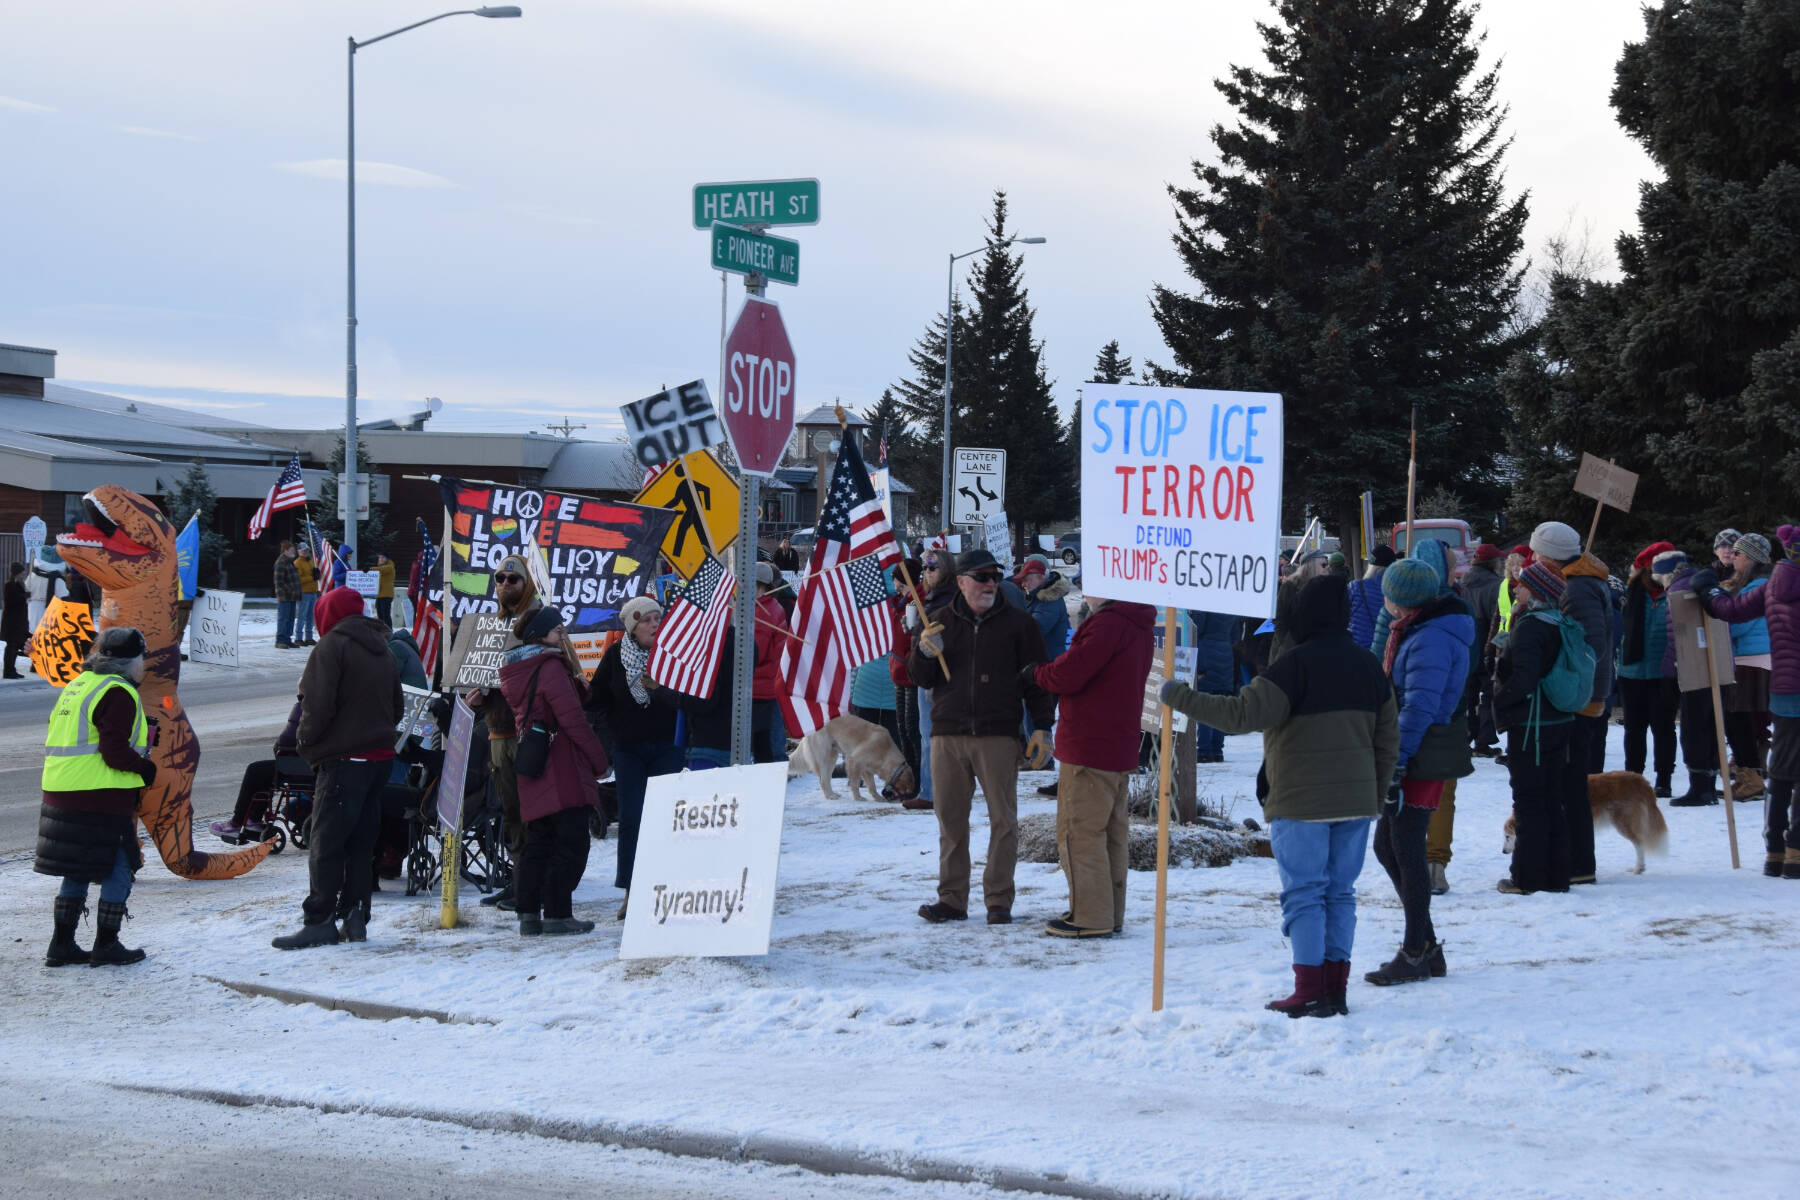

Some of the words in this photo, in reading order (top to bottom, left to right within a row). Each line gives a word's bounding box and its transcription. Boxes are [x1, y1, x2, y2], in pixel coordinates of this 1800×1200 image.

[703, 190, 775, 219] HEATH
[788, 194, 809, 215] ST
[717, 239, 723, 258] E
[728, 236, 775, 272] PIONEER
[779, 253, 795, 275] AVE
[728, 351, 791, 420] STOP
[623, 379, 713, 432] ICE
[636, 414, 717, 467] OUT
[1091, 398, 1187, 458] STOP
[1209, 403, 1267, 464] ICE
[960, 452, 997, 462] CENTER
[966, 462, 992, 471] LANE
[1115, 464, 1254, 522] TERROR
[965, 513, 989, 521] ONLY
[1136, 525, 1192, 548] DEFUND
[1174, 550, 1268, 594] GESTAPO
[208, 595, 228, 612] We
[201, 617, 227, 636] The
[476, 616, 518, 632] DISABLE
[193, 637, 235, 658] People
[475, 633, 506, 649] LIVES
[465, 650, 505, 669] MATTER
[455, 667, 473, 685] NO
[672, 793, 739, 832] Resist
[653, 867, 748, 925] Tyranny!
